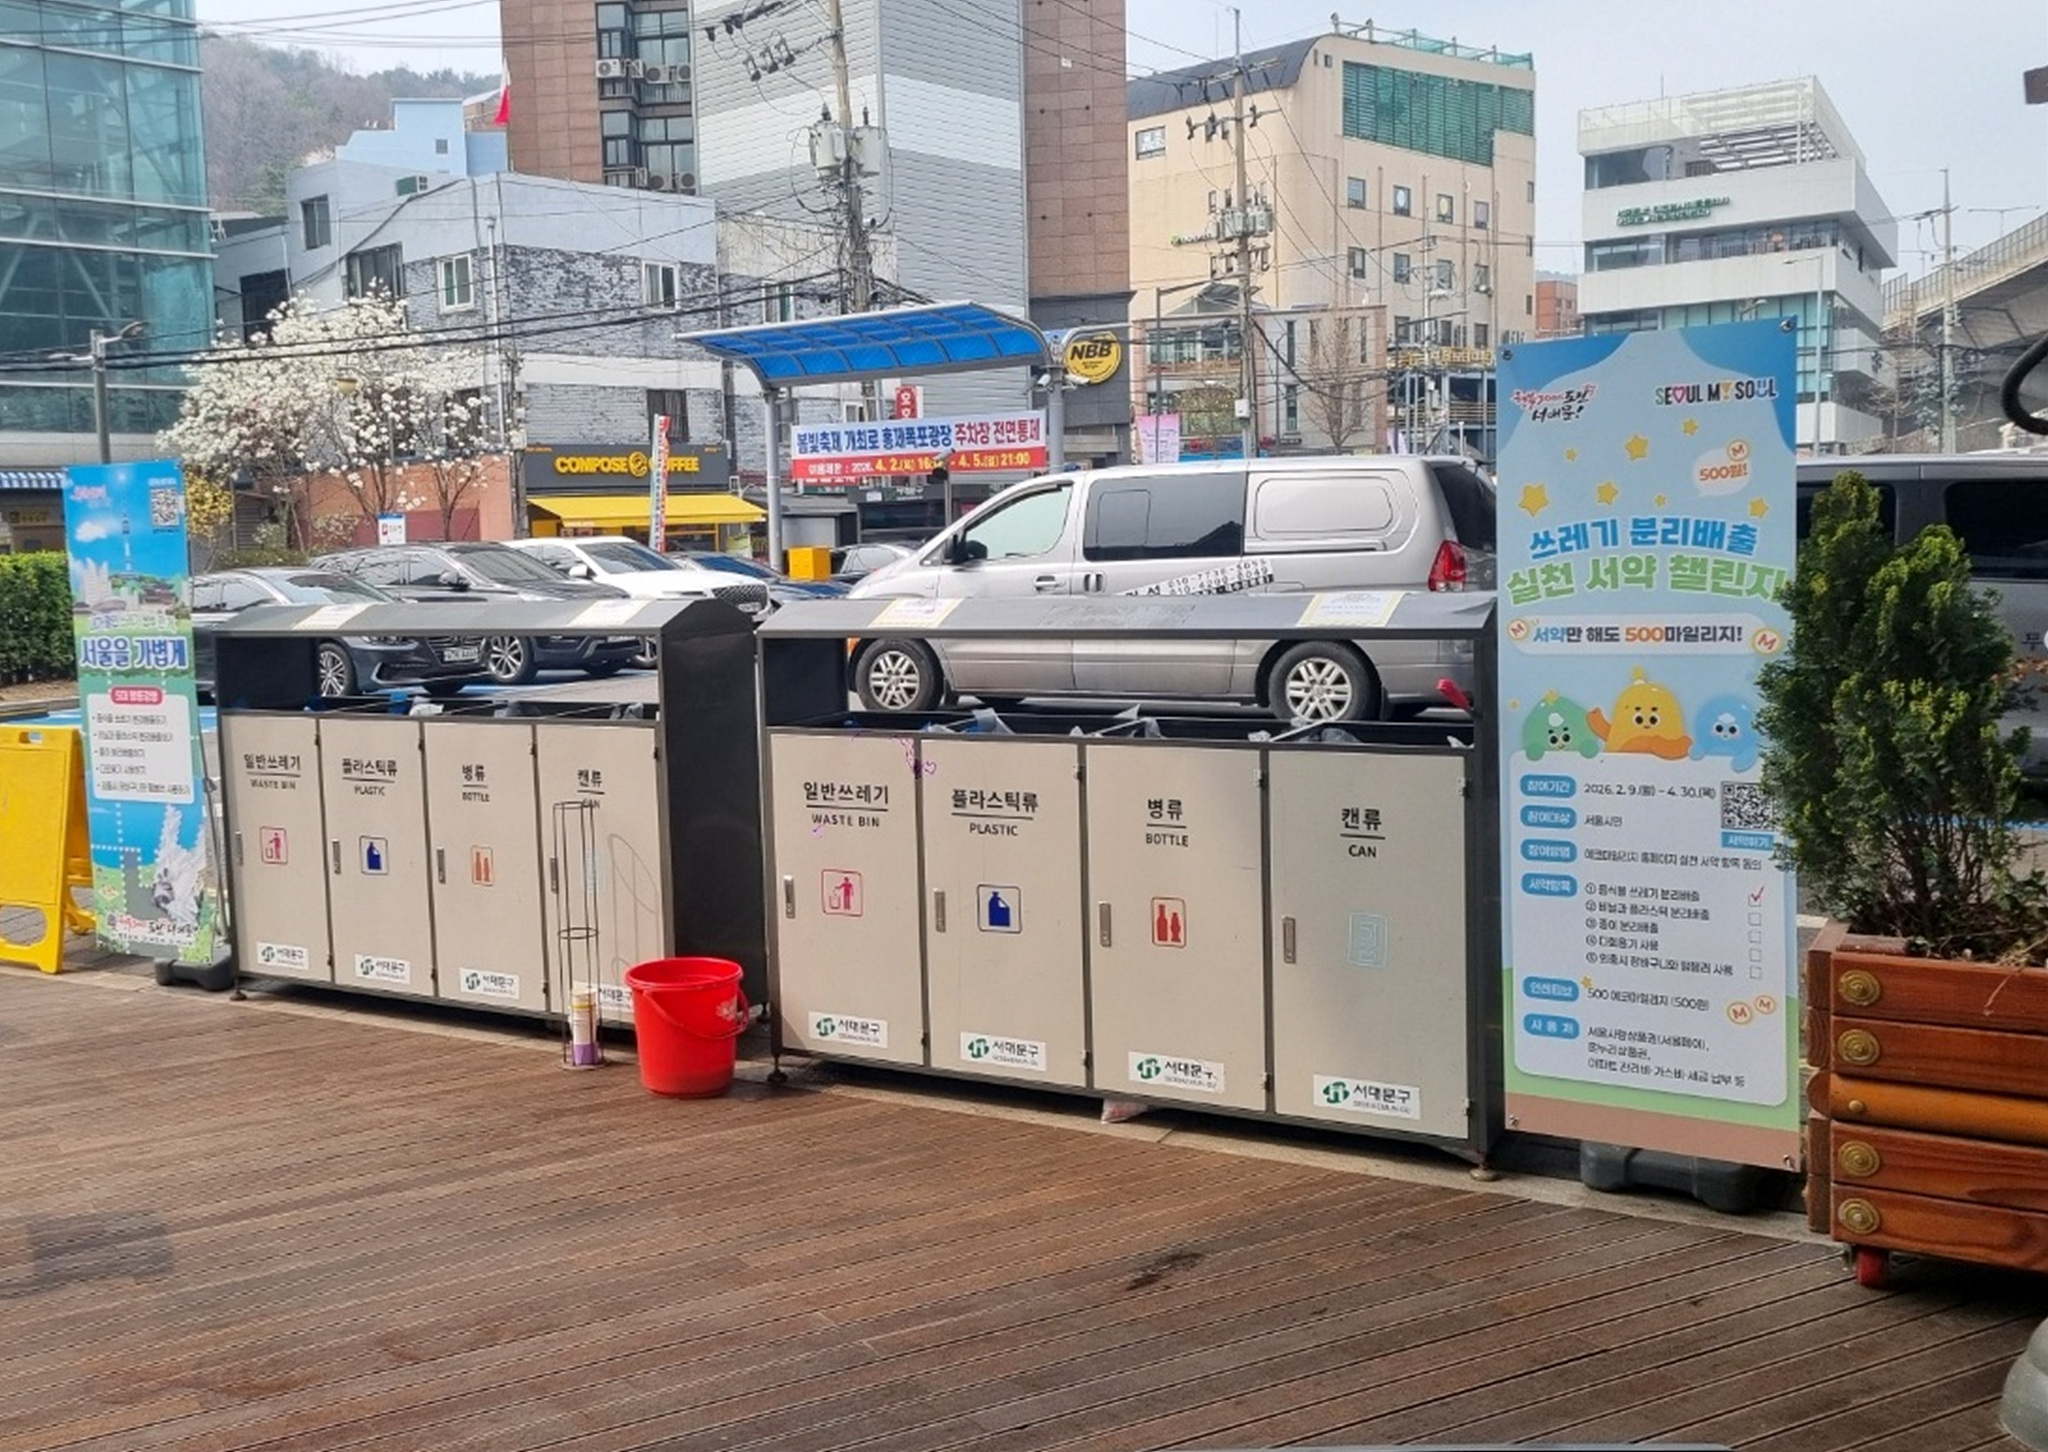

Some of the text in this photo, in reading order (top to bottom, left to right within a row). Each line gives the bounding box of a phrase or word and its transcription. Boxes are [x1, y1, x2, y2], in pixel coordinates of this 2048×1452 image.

[1070, 343, 1112, 361] NBB
[1734, 378, 1778, 400] SOUL
[797, 418, 1041, 454] 봄빛축제 개최로 홍제폭포광장 주차장 전면통제
[555, 456, 699, 473] COMPOSE FFEE
[999, 452, 1031, 467] 21:00
[1529, 517, 1758, 560] 쓰레기 분리배출
[1506, 555, 1789, 605] 실천 서약 챌린지
[1533, 625, 1743, 644] 서약만 해도 500마일리지!
[81, 637, 188, 668] 서울을 가볍게
[243, 753, 301, 770] 일반쓰레기
[341, 757, 398, 777] 플라스틱류
[462, 764, 485, 782] 병류
[577, 769, 602, 787] 캔류
[250, 778, 296, 790] WASTE BIN
[354, 785, 386, 796] PLASTIC
[1584, 783, 1614, 795] 2026.
[462, 791, 490, 803] BOTTLE
[803, 782, 889, 805] 일반쓰레기
[951, 788, 1039, 813] 플라스틱류
[1147, 798, 1183, 821] 병류
[812, 813, 880, 828] WASTE BIN
[1341, 807, 1382, 831] 캔류
[969, 822, 1018, 837] PLASTIC
[1145, 832, 1189, 848] BOTTLE
[1348, 844, 1377, 858] CAN
[1587, 987, 1609, 1000] 500
[838, 1018, 881, 1036] 서대문구
[992, 1039, 1039, 1058] 서대문구
[1353, 1082, 1411, 1105] 서대문구
